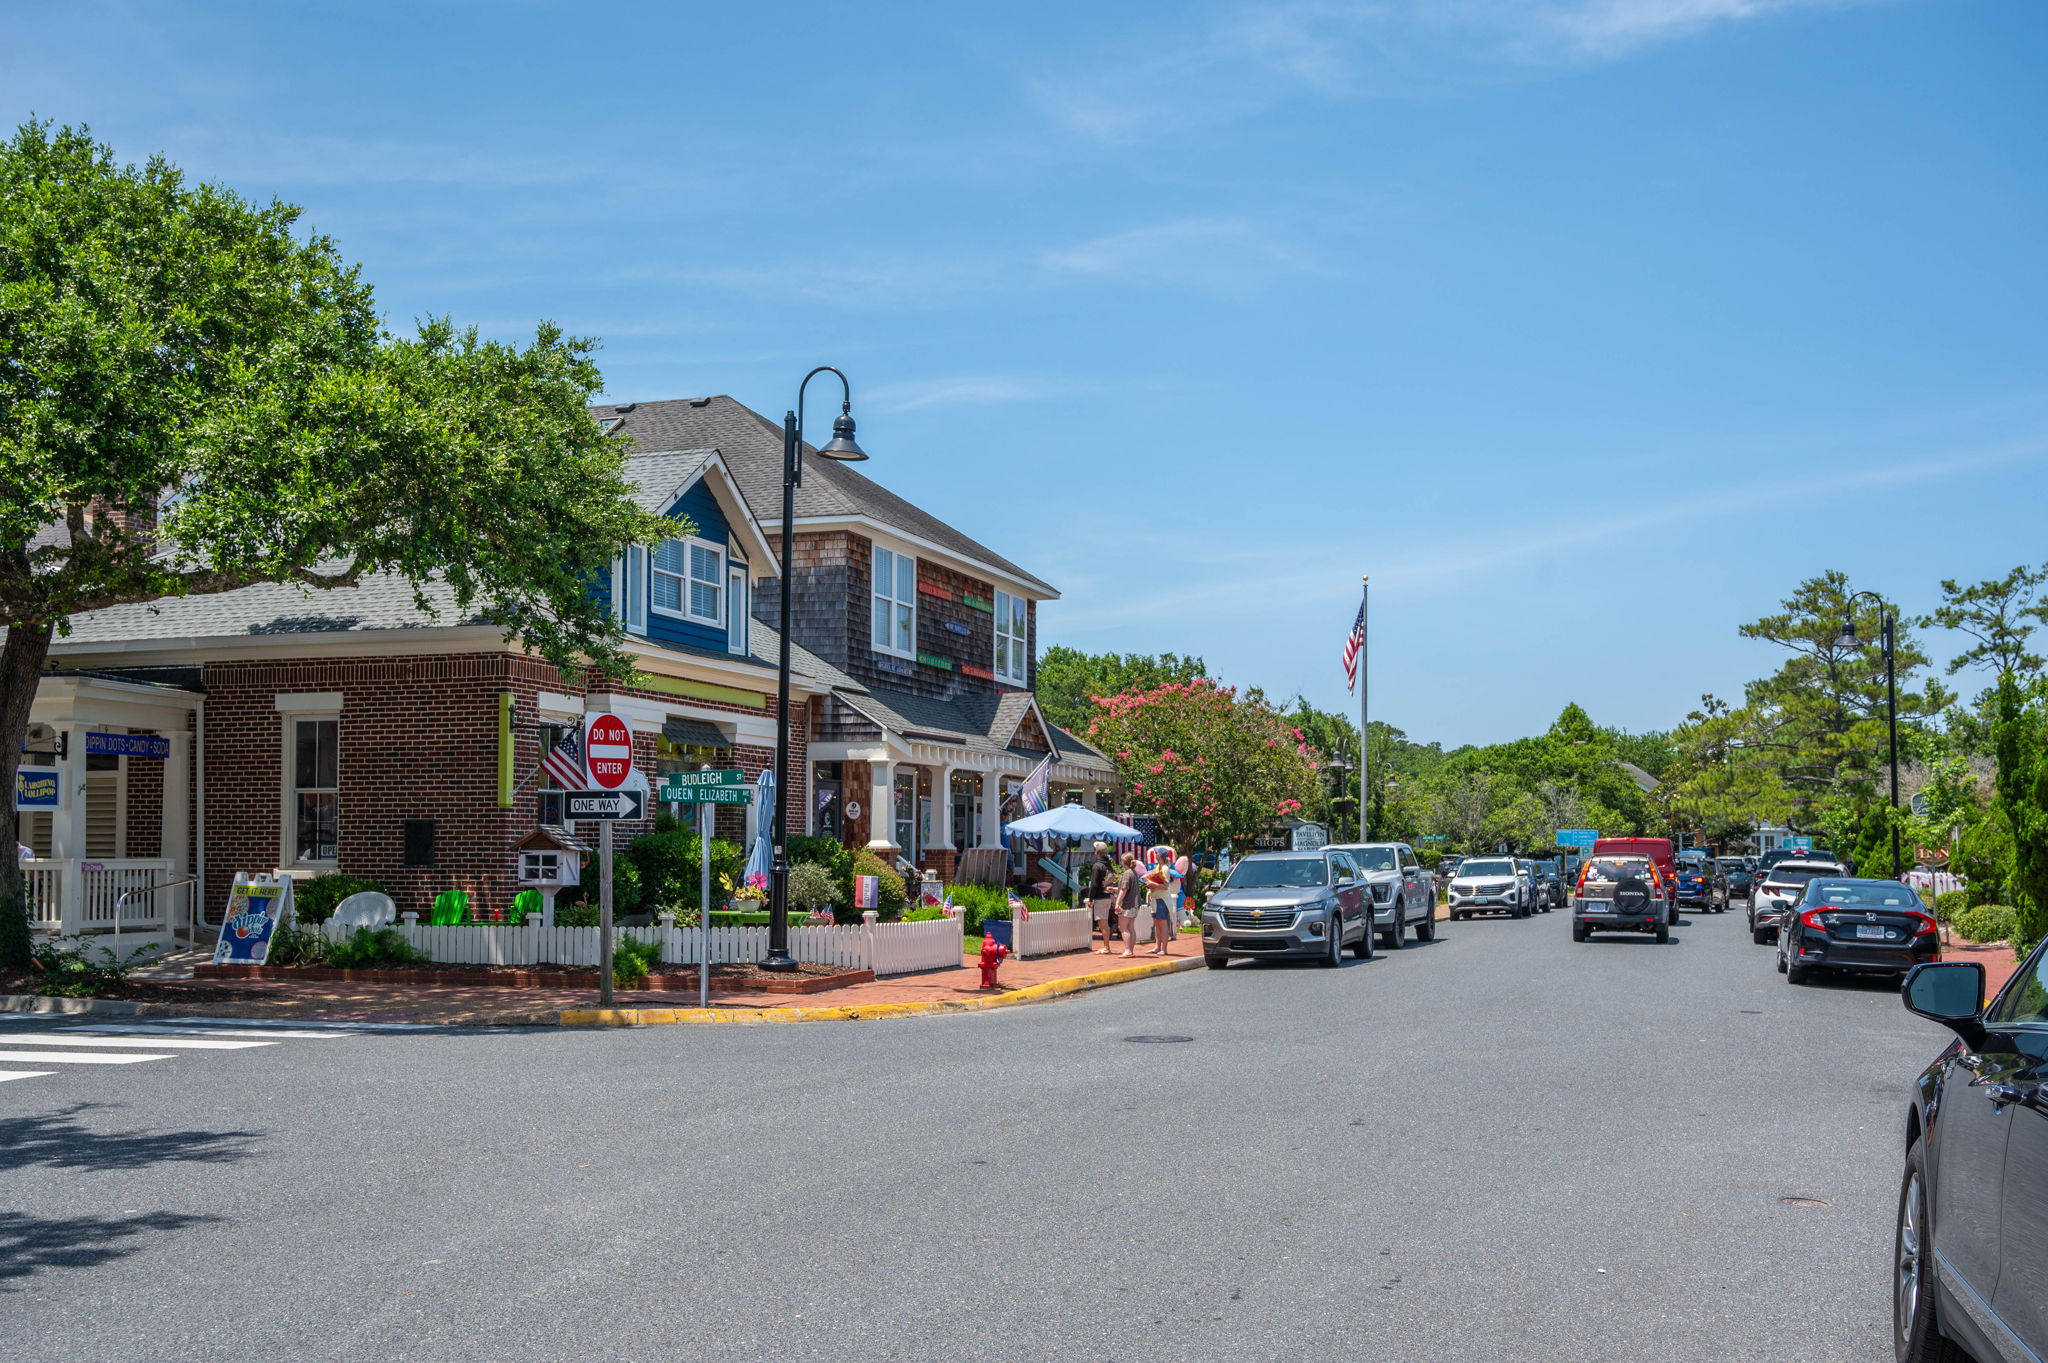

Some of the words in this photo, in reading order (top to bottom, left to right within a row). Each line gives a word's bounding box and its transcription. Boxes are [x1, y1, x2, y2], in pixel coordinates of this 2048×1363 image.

[593, 729, 604, 740] DO
[609, 730, 625, 741] NOT
[108, 738, 126, 752] DOTS
[128, 739, 149, 753] CANDY
[153, 741, 169, 755] SODA
[597, 762, 622, 774] ENTER
[681, 772, 722, 786] BUDLEIGH
[25, 788, 56, 798] LOLLIPOP
[666, 788, 693, 799] QUEEN
[699, 789, 738, 801] ELIZABETH
[573, 800, 595, 811] ONE
[598, 800, 620, 811] WAY
[1254, 839, 1285, 847] SHOPS
[237, 887, 249, 895] GET
[259, 888, 278, 896] HERE!
